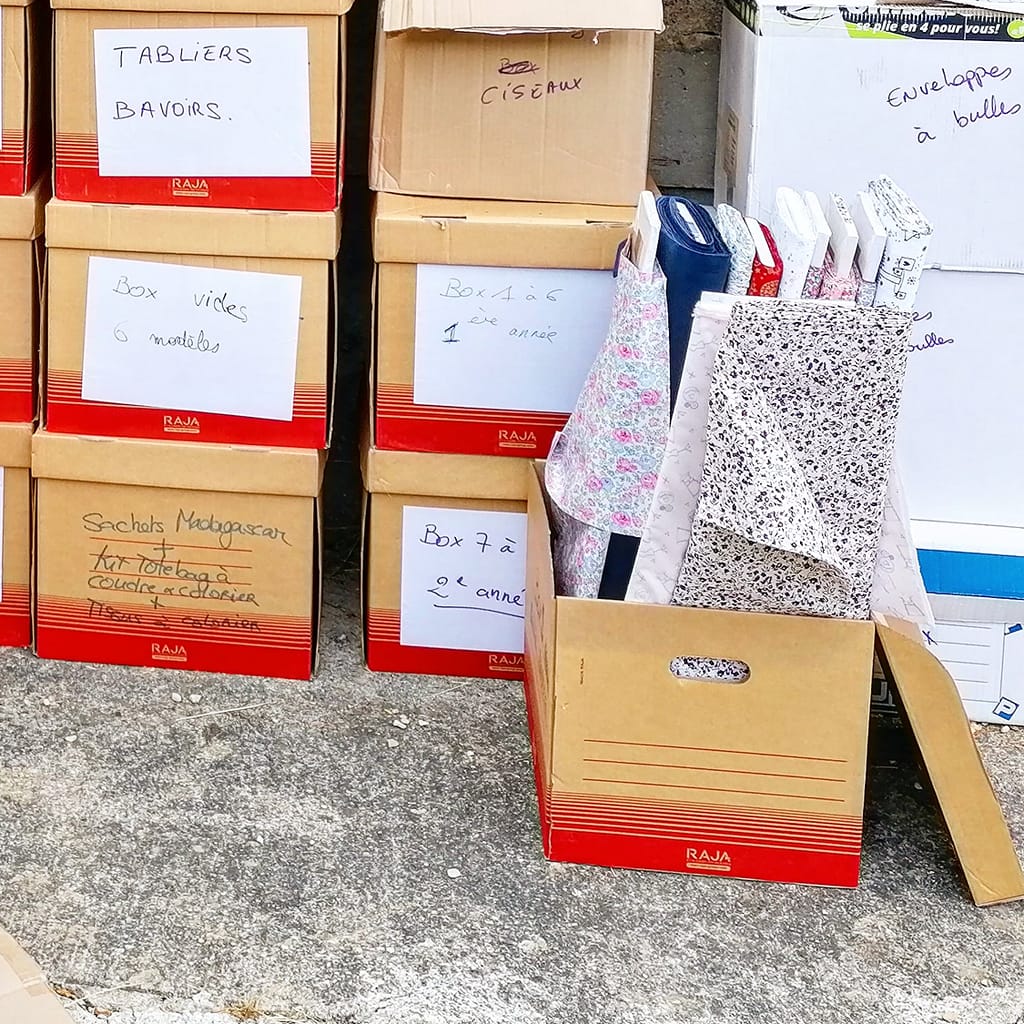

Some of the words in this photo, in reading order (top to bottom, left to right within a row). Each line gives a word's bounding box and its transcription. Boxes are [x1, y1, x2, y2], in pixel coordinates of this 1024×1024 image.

[873, 21, 898, 33] plie
[901, 24, 917, 33] en
[919, 22, 929, 33] 4
[929, 23, 963, 36] pour
[965, 23, 1001, 35] vous!
[913, 126, 936, 144] à
[953, 95, 1022, 128] bulles
[172, 178, 209, 190] RAJA
[112, 275, 158, 299] Box
[194, 289, 248, 323] vides
[439, 277, 486, 298] Box
[491, 285, 515, 302] 1
[525, 285, 537, 301] à
[546, 288, 564, 302] 6
[113, 320, 128, 343] 6
[163, 415, 201, 427] RAJA
[498, 429, 538, 441] RAJA
[82, 512, 165, 533] Sachets
[176, 508, 292, 550] Madagascar
[420, 523, 464, 548] Box
[476, 532, 492, 553] 7
[500, 537, 516, 554] à
[153, 537, 174, 559] +
[150, 596, 165, 610] +
[475, 588, 526, 607] anné
[151, 642, 187, 655] RAJA
[685, 847, 732, 863] RAJA
